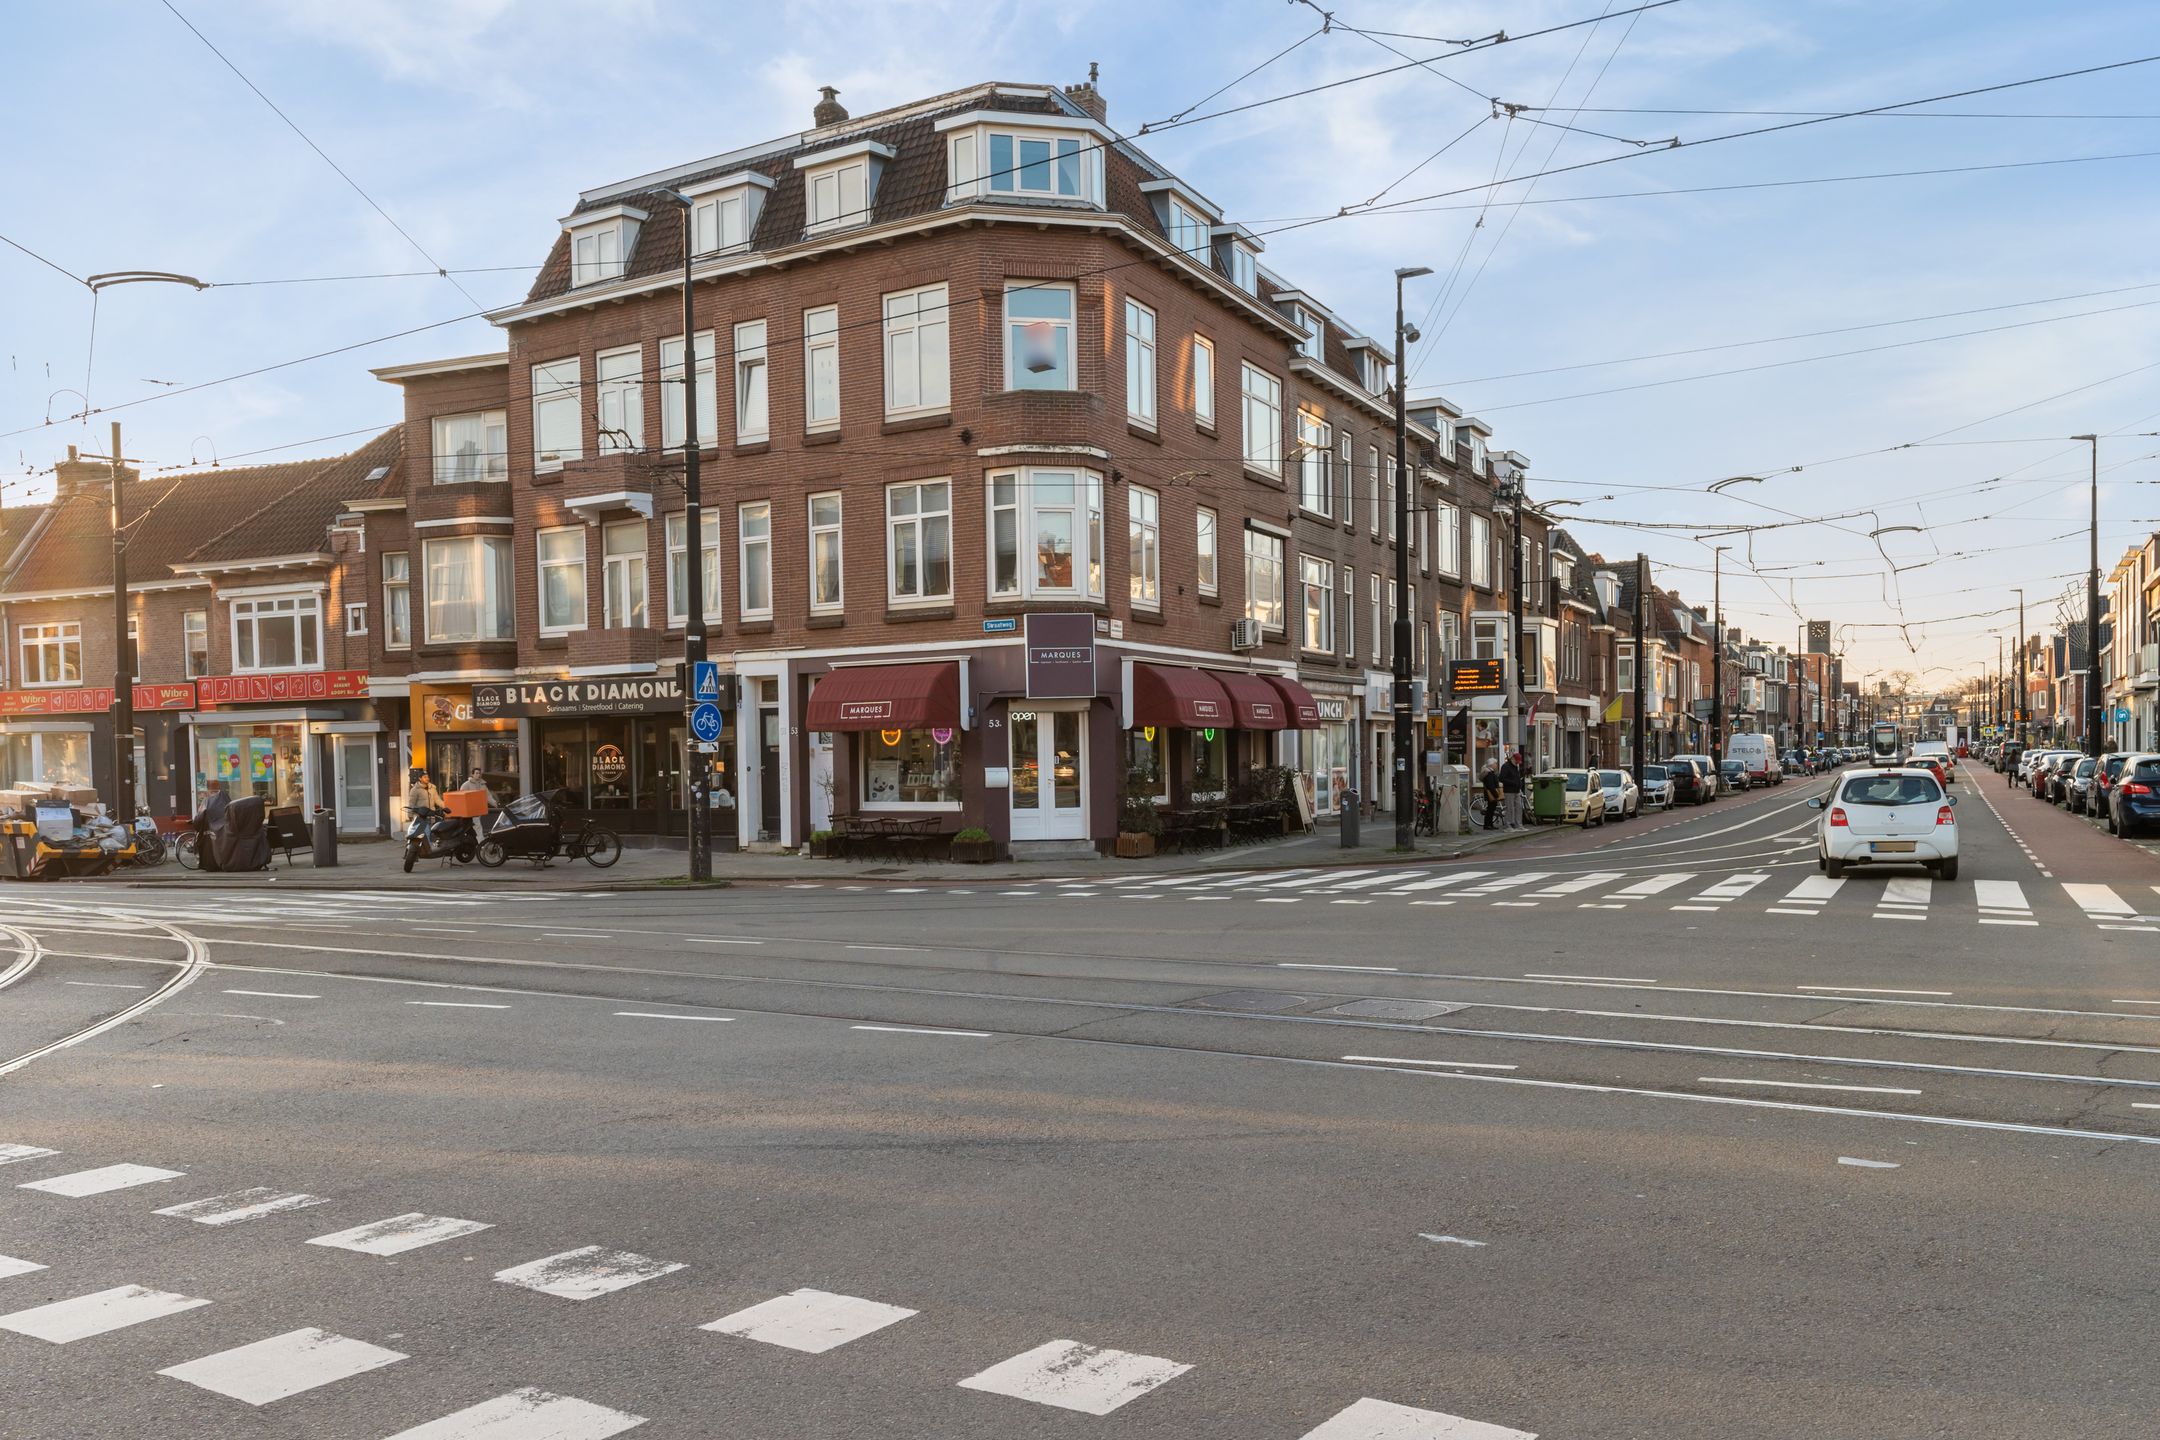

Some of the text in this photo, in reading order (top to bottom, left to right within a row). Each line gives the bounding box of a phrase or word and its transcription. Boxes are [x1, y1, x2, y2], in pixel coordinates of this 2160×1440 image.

[986, 621, 1012, 629] Straatweg
[1041, 651, 1081, 659] MARQUES
[160, 686, 189, 698] Wibra
[506, 685, 580, 704] BLACK
[20, 692, 47, 704] Wibra
[546, 702, 644, 713] Surinaams Streetfood Catering
[1317, 701, 1342, 718] UNCH
[1011, 712, 1036, 722] open
[592, 756, 625, 764] BLACK
